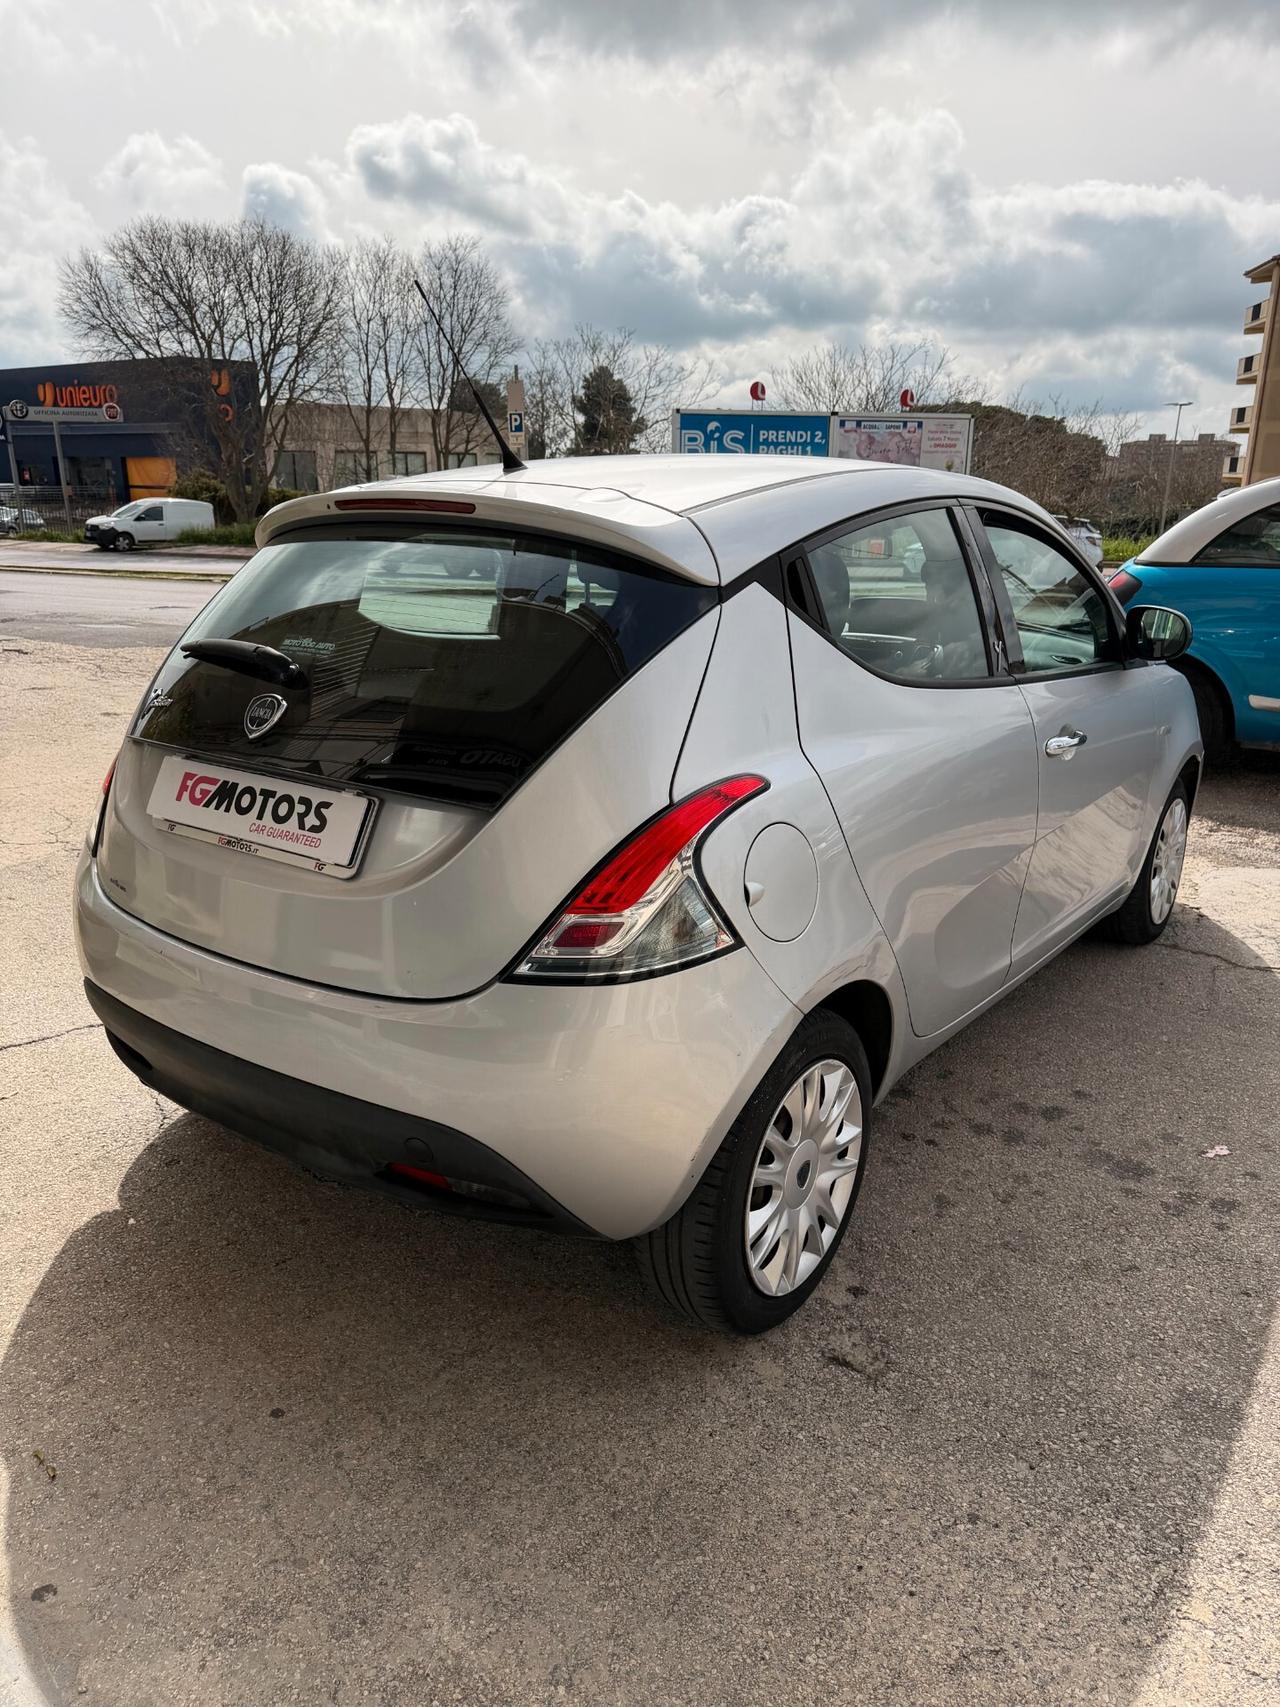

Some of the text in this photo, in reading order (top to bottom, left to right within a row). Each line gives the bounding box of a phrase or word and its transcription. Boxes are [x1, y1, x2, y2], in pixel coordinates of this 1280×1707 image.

[511, 414, 521, 431] P
[759, 431, 826, 444] PRENDI 2,
[759, 445, 802, 455] PAGHI
[249, 822, 322, 849] CAR GUARANTEED
[313, 862, 327, 871] FG
